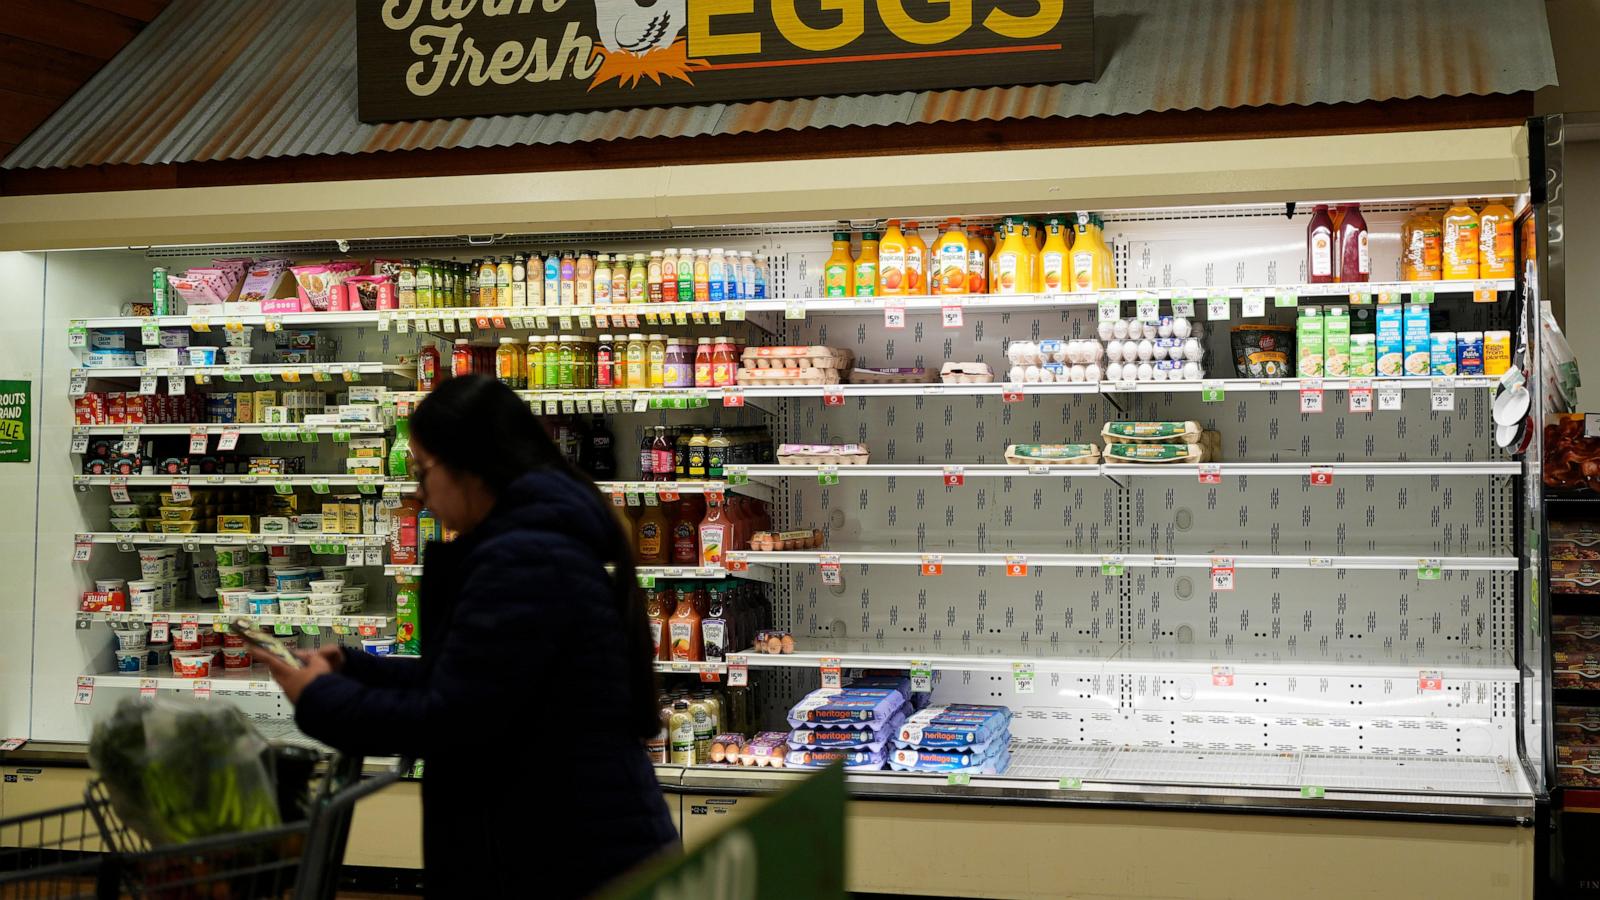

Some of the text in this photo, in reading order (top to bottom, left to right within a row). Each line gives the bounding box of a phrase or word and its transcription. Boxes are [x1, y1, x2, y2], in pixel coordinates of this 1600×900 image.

[406, 22, 605, 96] Fresh
[816, 709, 851, 720] heritage
[816, 732, 851, 741] heritage
[924, 731, 956, 740] heritage
[920, 754, 951, 763] heritage
